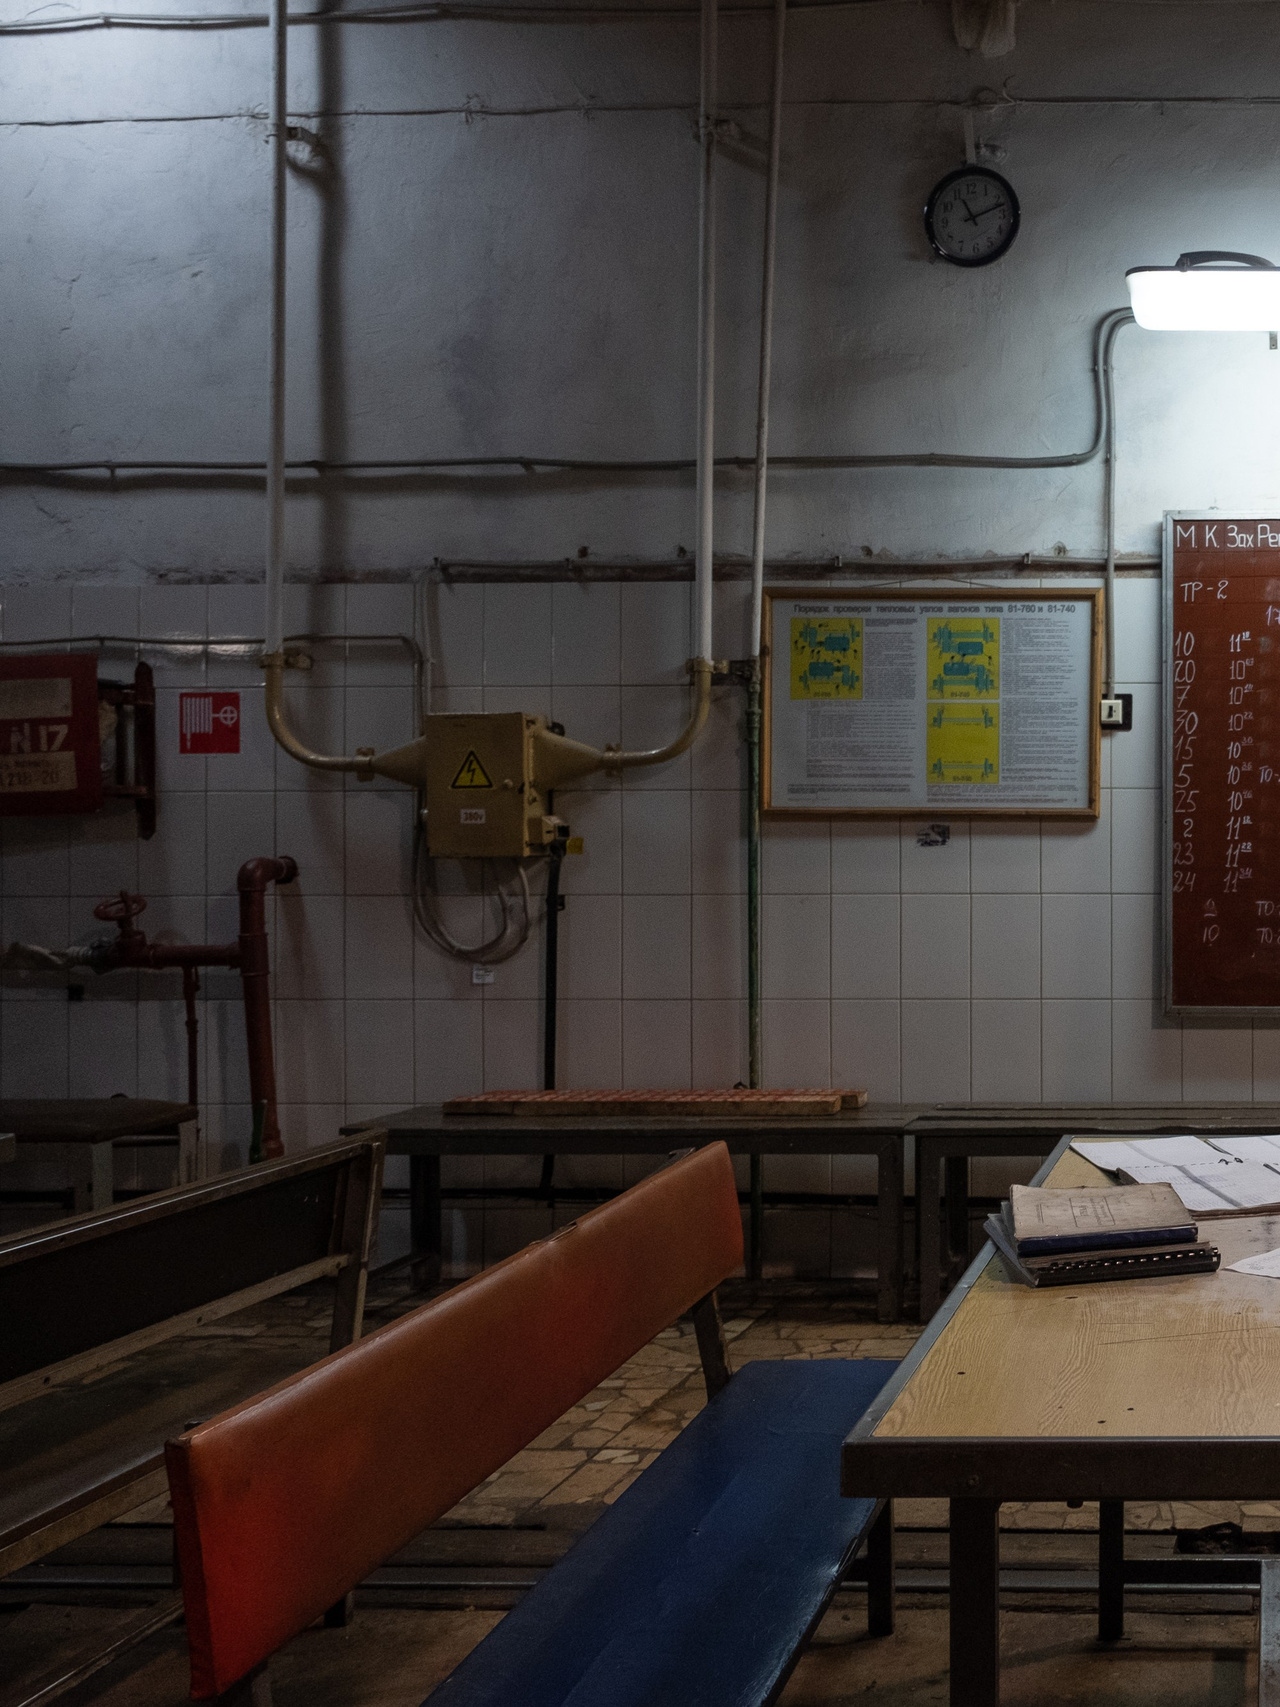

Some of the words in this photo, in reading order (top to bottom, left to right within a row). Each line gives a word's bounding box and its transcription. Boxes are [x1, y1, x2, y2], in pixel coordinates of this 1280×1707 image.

[966, 182, 977, 195] 12
[942, 217, 948, 229] 9
[998, 209, 1006, 220] 3
[958, 240, 964, 252] 7
[972, 243, 980, 254] 6
[794, 604, 829, 614] Порядок
[833, 605, 871, 614] проверки
[876, 605, 915, 613] тепловых
[919, 605, 944, 613] узлов
[947, 605, 980, 613] вагонов
[985, 605, 1004, 613] типа
[1175, 631, 1195, 657] 10
[1174, 659, 1196, 683] 20
[1175, 685, 1191, 708] 7
[1174, 709, 1198, 735] 30
[1175, 735, 1197, 761] 15
[1175, 763, 1194, 788] 5
[1174, 790, 1200, 813] 25
[1183, 818, 1194, 838] 2
[1173, 842, 1194, 865] 23
[1173, 870, 1196, 893] 24
